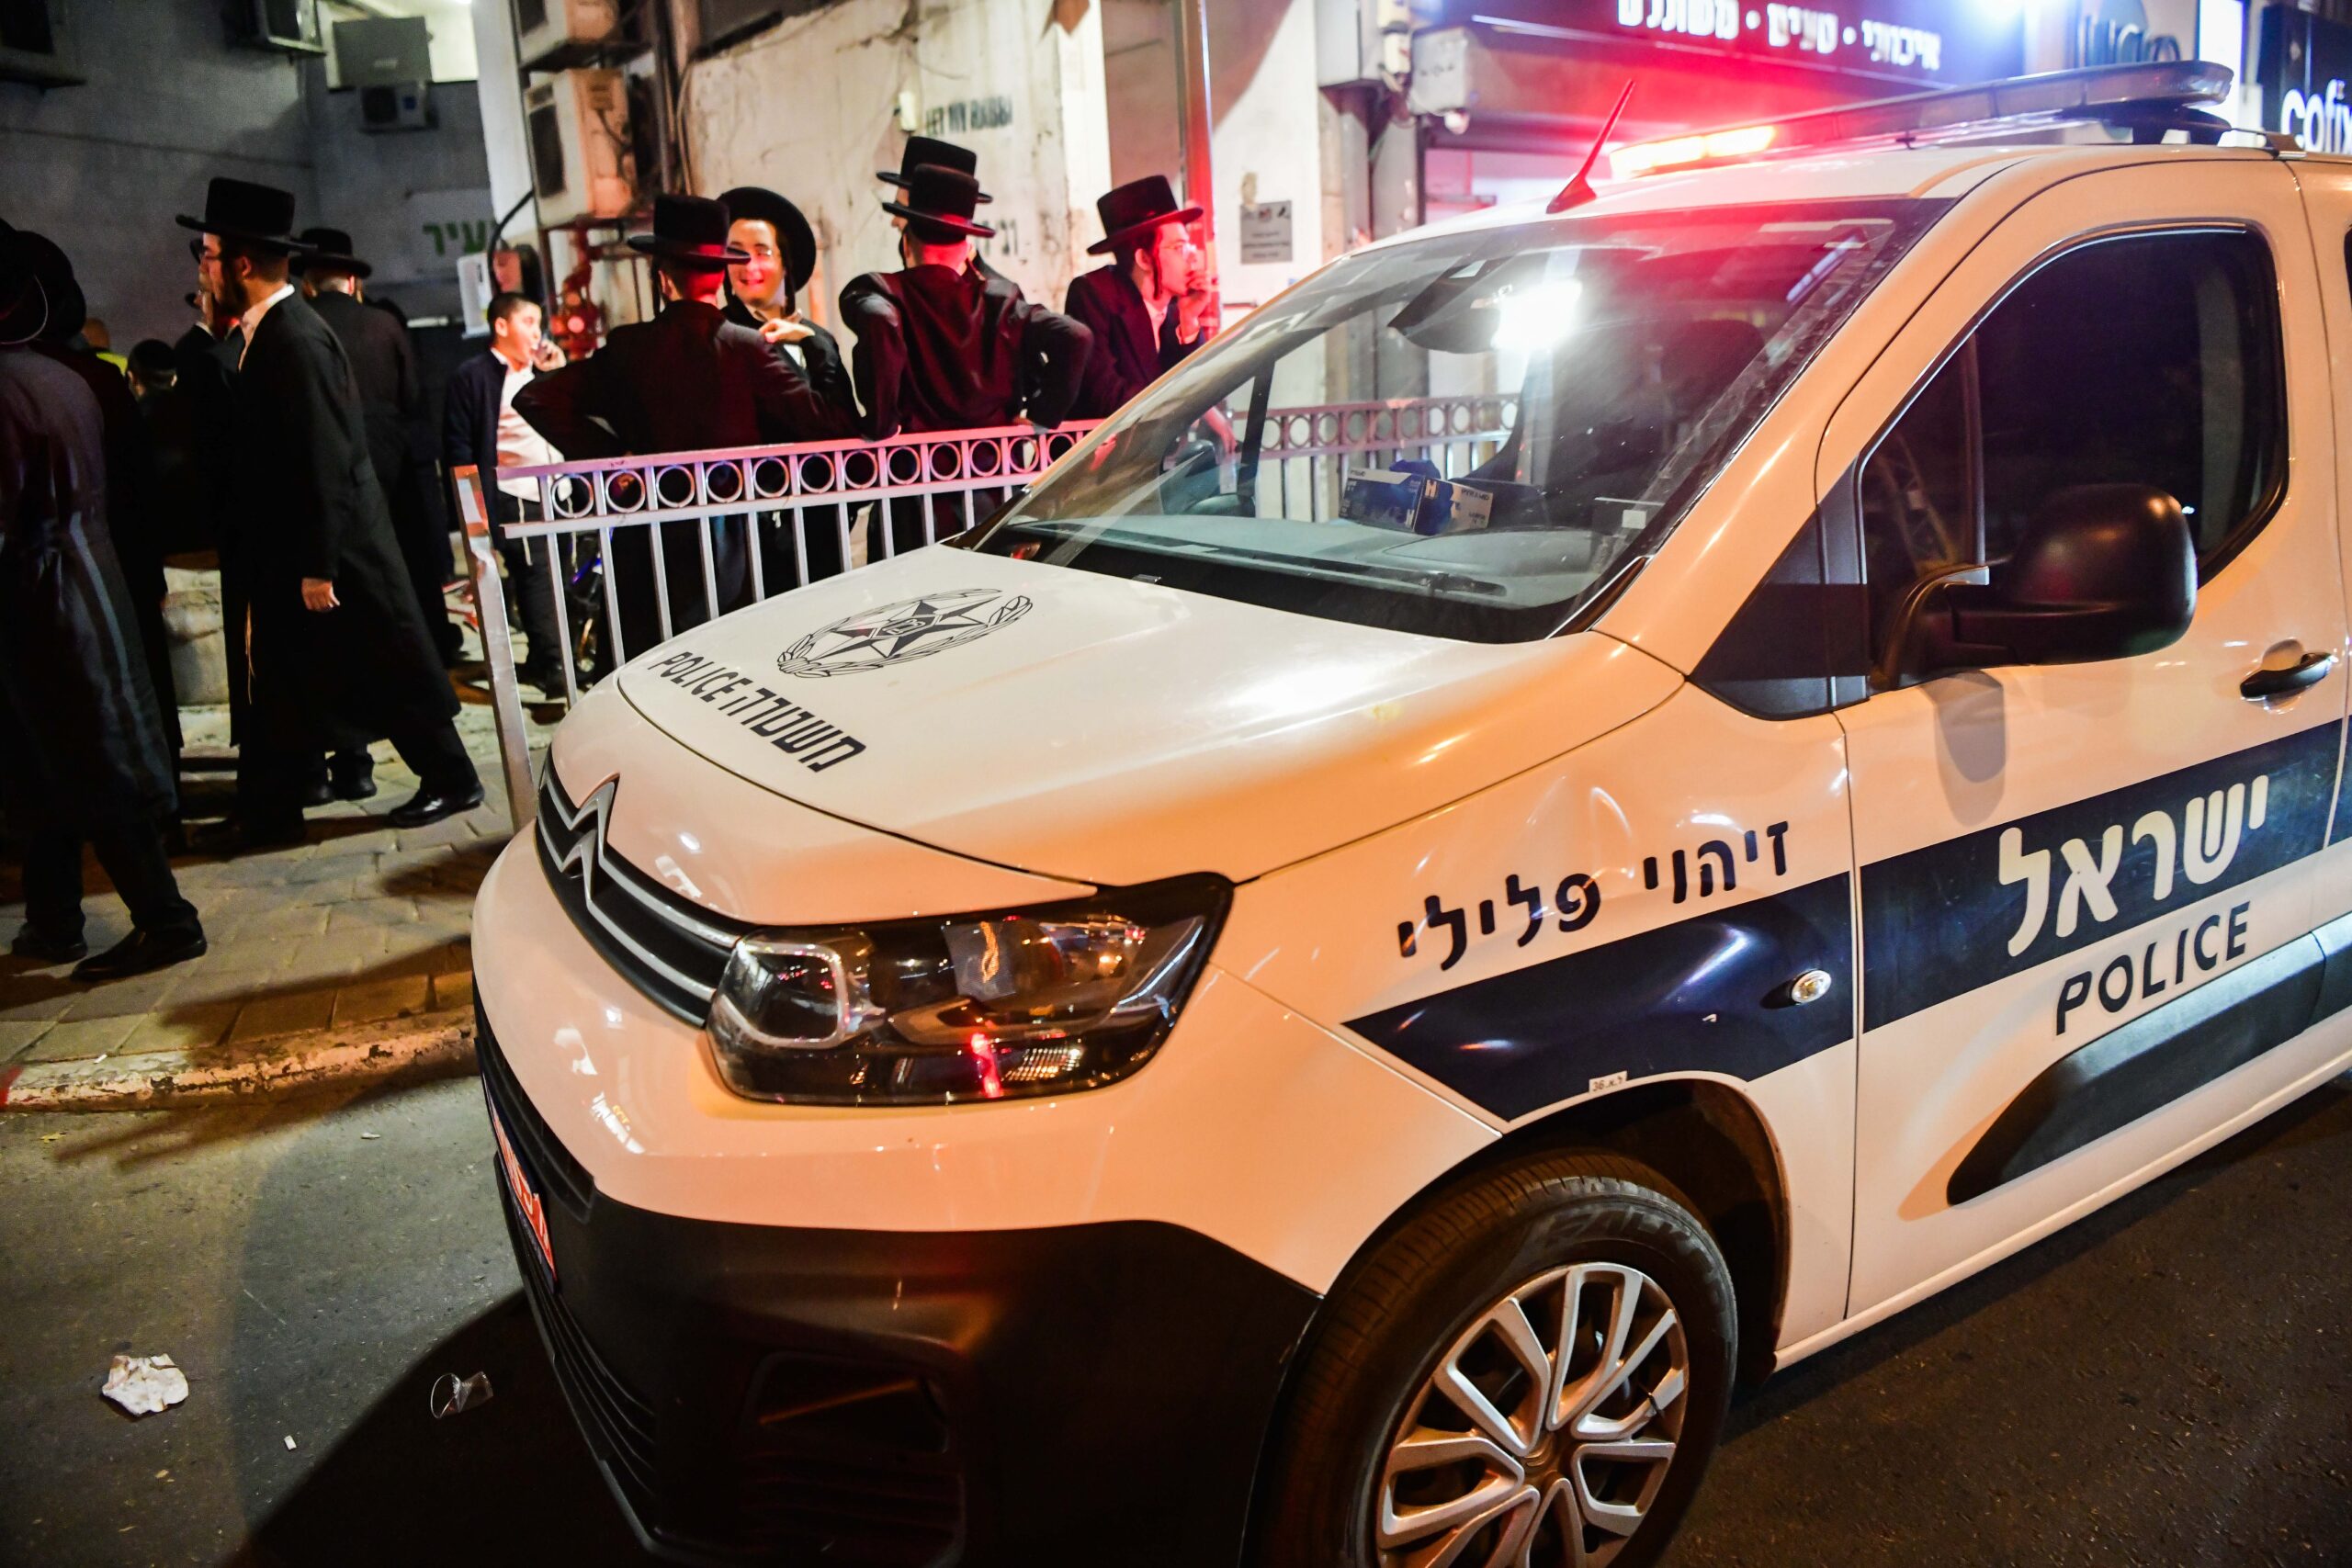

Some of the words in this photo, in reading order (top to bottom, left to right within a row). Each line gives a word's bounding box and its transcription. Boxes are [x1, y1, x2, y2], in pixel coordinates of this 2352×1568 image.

[648, 651, 753, 703] POLICE
[718, 687, 866, 773] משטרה
[1643, 820, 1789, 904] זיהוי
[1999, 774, 2268, 957] ישראל
[1397, 873, 1600, 971] פלילי
[2055, 900, 2251, 1036] POLICE
